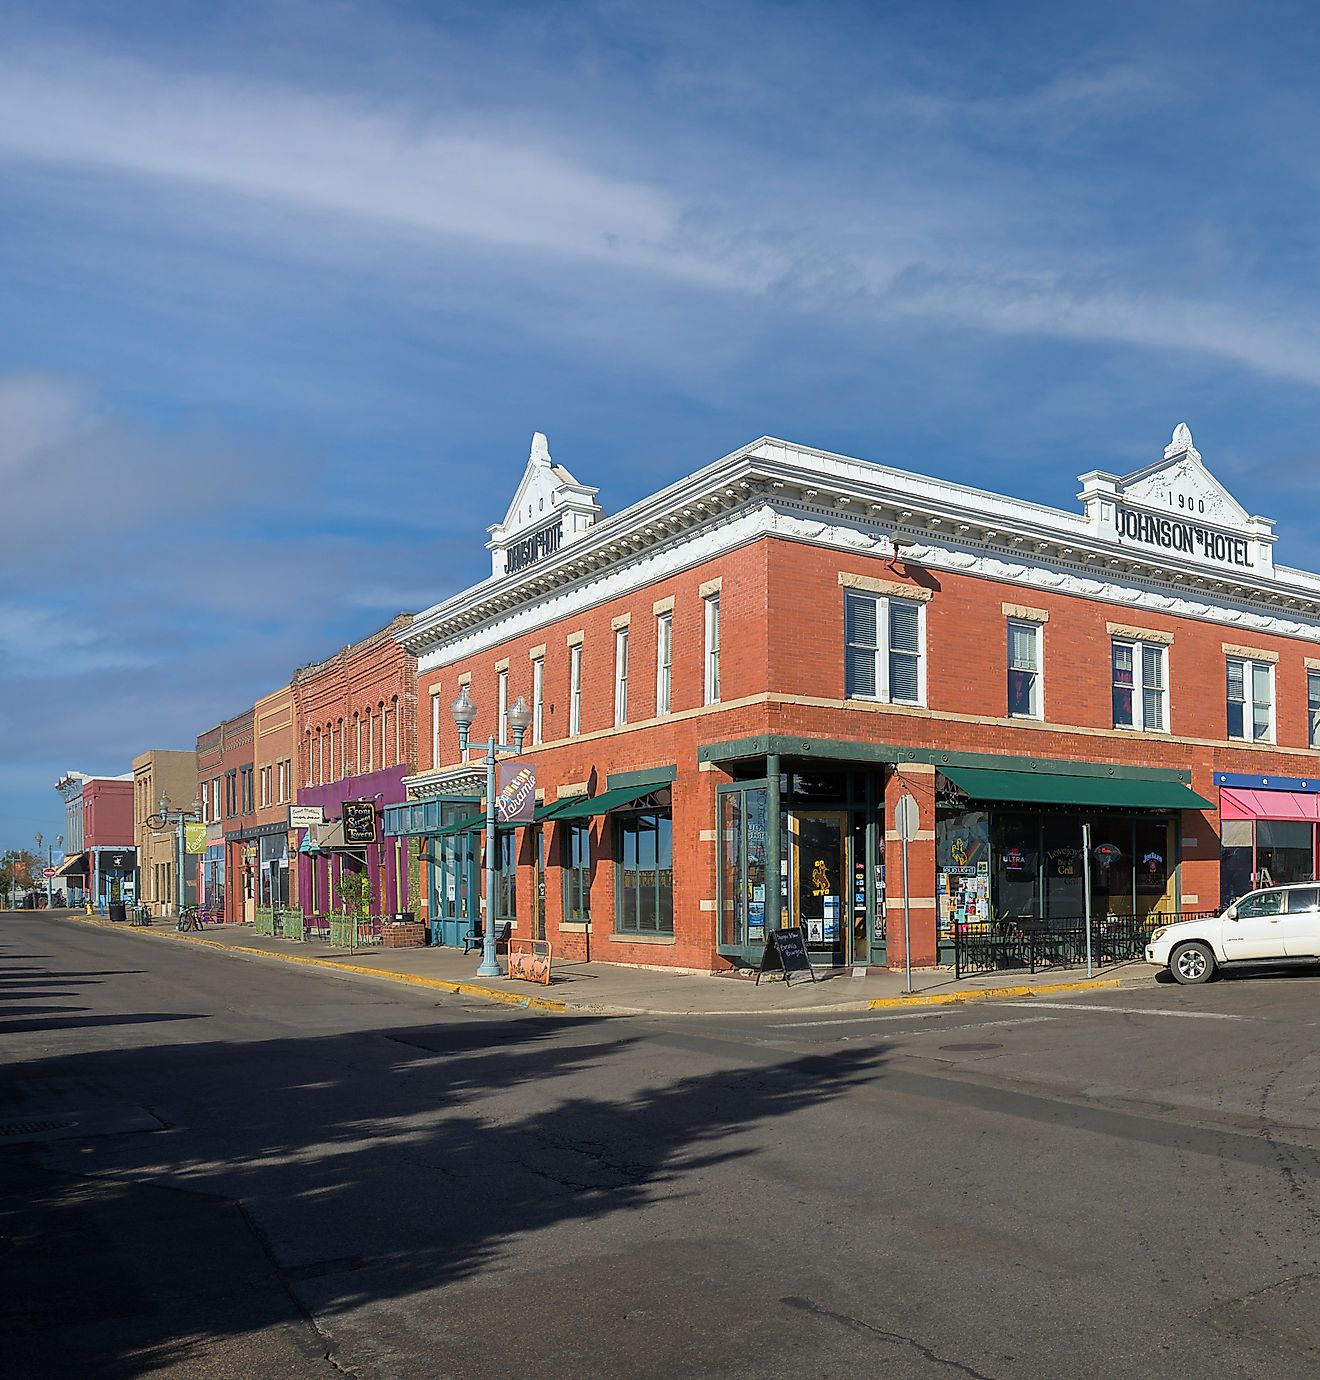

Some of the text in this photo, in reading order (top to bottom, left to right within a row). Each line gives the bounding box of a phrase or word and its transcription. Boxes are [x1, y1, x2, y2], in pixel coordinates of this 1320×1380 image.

[1168, 491, 1205, 514] 1900
[1204, 530, 1255, 568] HOTEL
[498, 775, 537, 822] Laramie
[347, 805, 371, 816] Front
[347, 816, 371, 828] Street
[347, 828, 373, 838] Tavern
[1057, 865, 1074, 875] Grill
[812, 888, 830, 896] WYO
